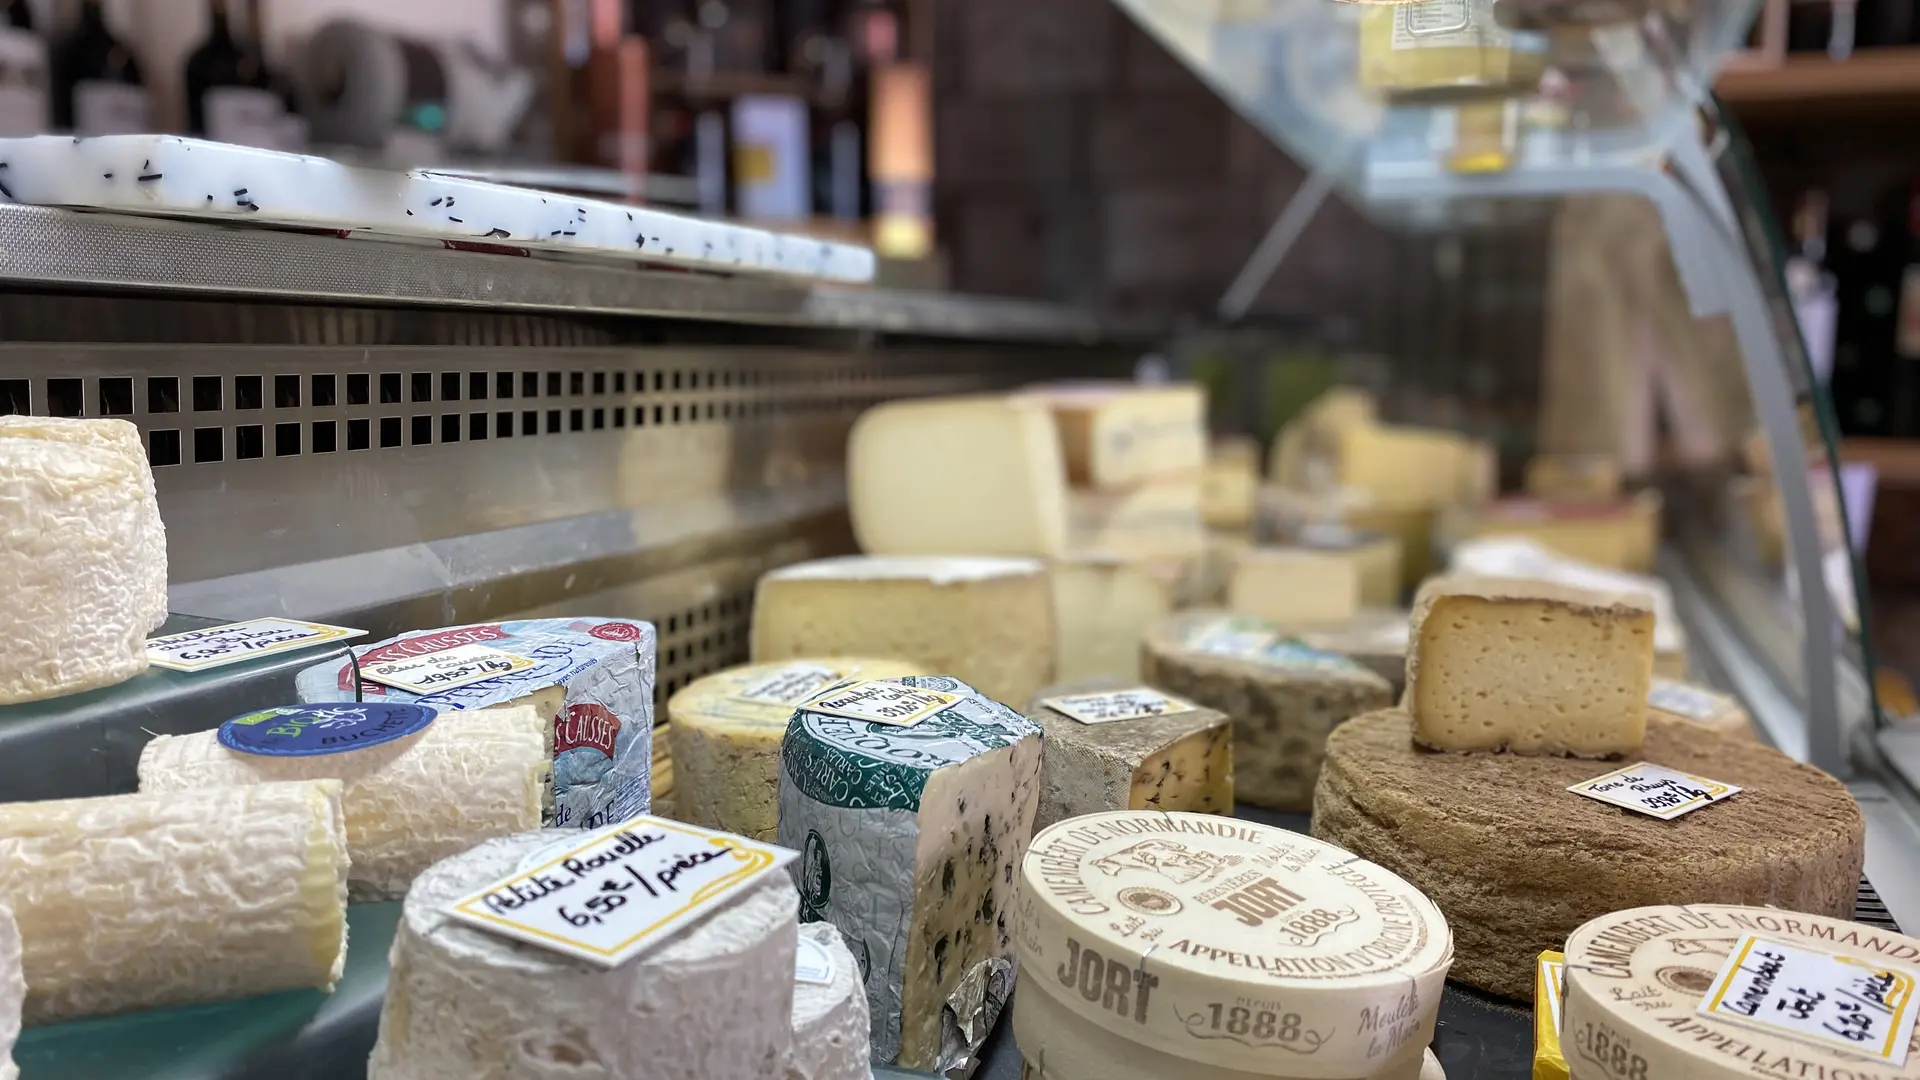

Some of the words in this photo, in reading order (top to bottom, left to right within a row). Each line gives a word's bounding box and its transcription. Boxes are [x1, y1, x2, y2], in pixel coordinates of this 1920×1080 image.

[398, 628, 499, 655] CAUSSES
[564, 710, 616, 750] CAUSSES
[804, 752, 849, 802] CARLES
[1621, 773, 1645, 788] de
[1068, 826, 1112, 846] DE
[1097, 817, 1266, 844] NORMANDIE
[480, 870, 577, 915] Petite
[560, 830, 666, 879] Rouelle
[1040, 837, 1110, 915] CAMEMBERT
[1192, 869, 1265, 905] BERNIÈRES
[1321, 859, 1411, 919] PROTÉGÉE
[1210, 876, 1307, 927] JORT
[1279, 907, 1342, 940] 1888
[1346, 915, 1414, 969] D'ORIGINE
[1167, 939, 1351, 974] APPELLATION
[1585, 915, 1684, 979] CAMEMBERT
[1677, 911, 1729, 930] DE
[1057, 937, 1160, 1026] JORT
[1609, 985, 1664, 1001] Lait
[1206, 1002, 1303, 1043] 1888
[1236, 996, 1282, 1011] DEPUIS
[1585, 1021, 1649, 1080] 1888
